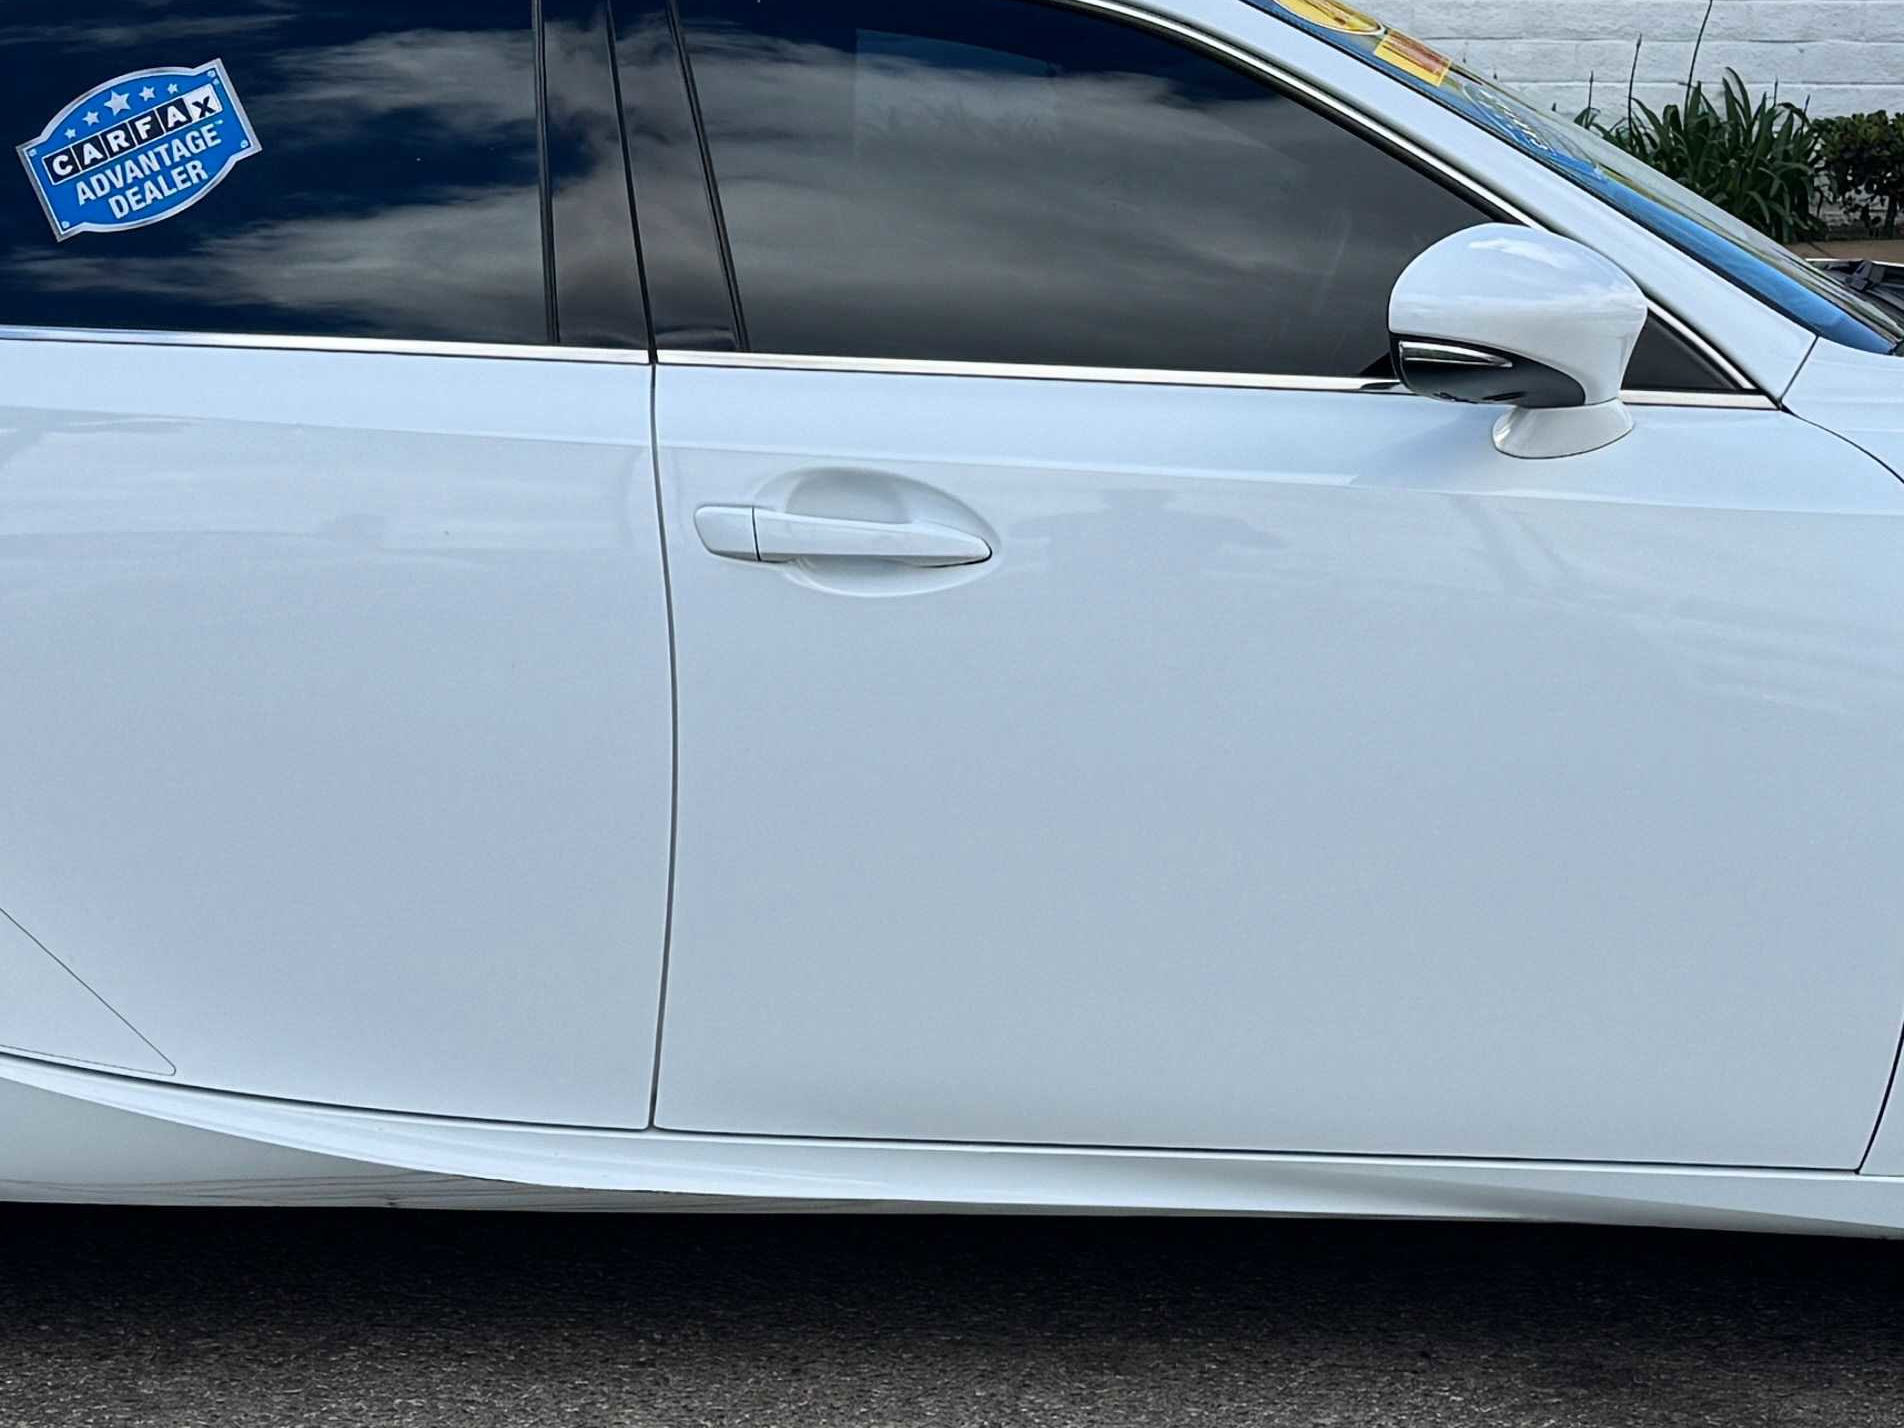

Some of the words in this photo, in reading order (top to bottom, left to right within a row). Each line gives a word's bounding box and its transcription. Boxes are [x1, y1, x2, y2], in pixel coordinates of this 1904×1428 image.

[51, 96, 218, 176] CARFAX
[75, 125, 222, 205] ADVANTAGE
[108, 160, 209, 219] DEALER
